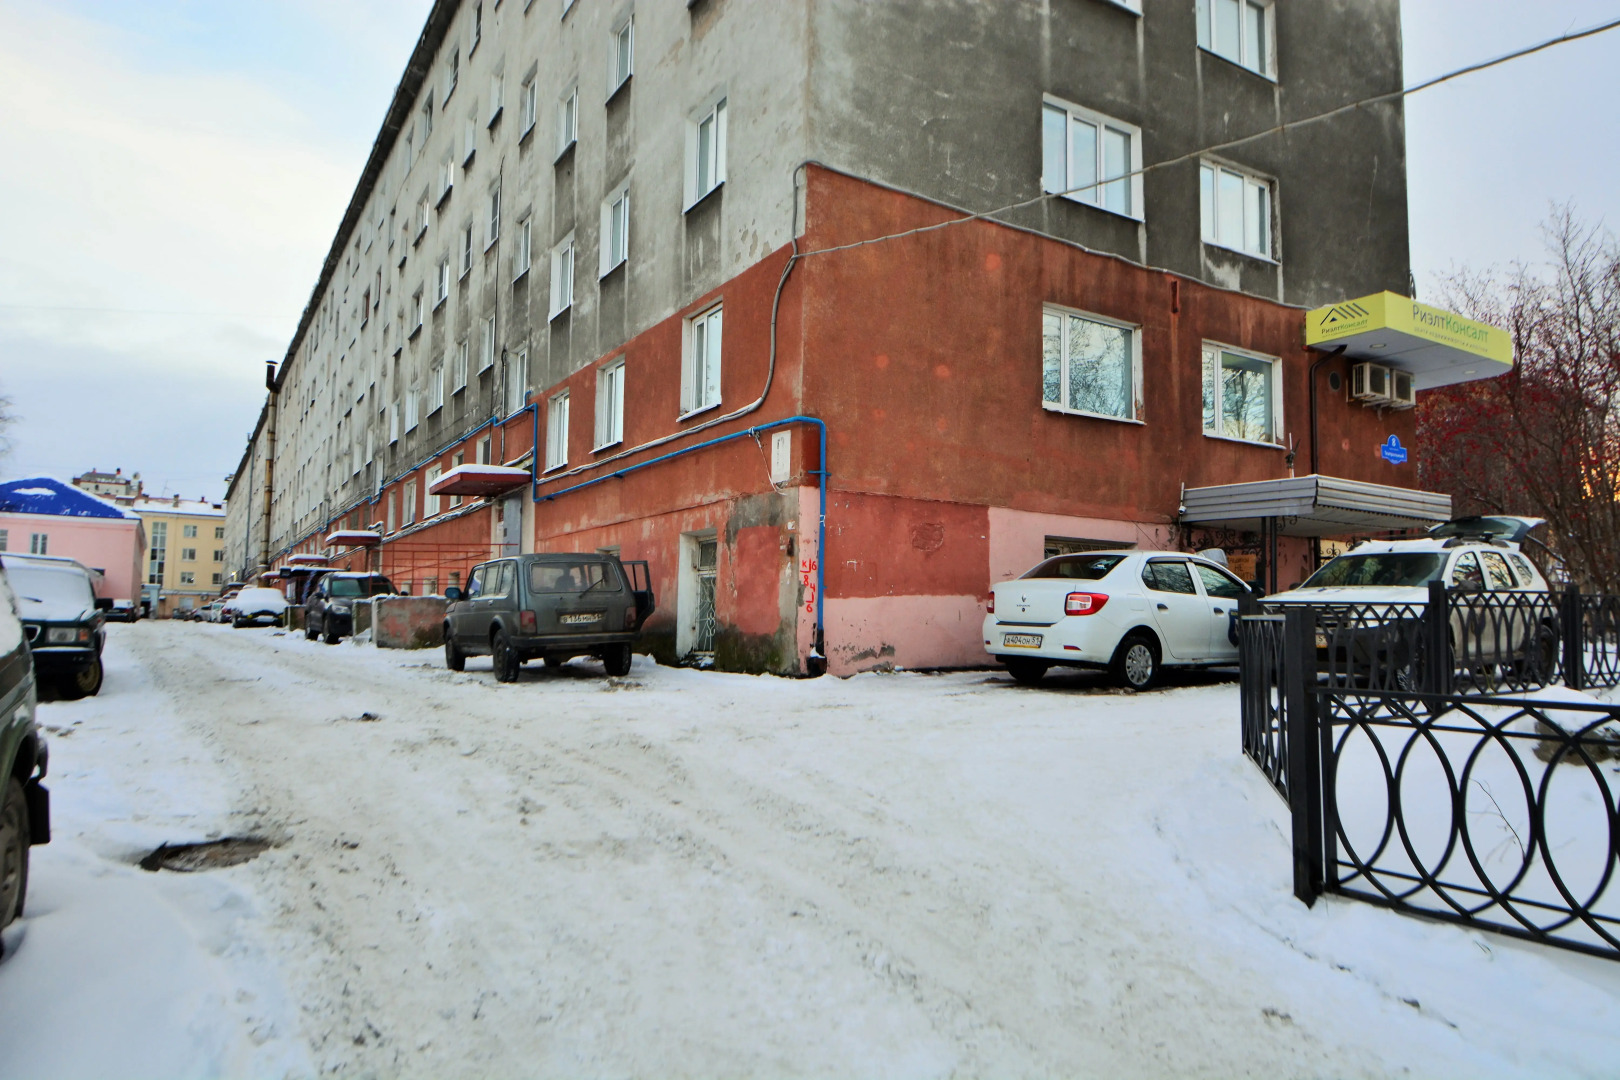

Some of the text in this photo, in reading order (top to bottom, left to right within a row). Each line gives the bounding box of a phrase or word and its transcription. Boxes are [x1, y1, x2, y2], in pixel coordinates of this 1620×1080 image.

[1321, 319, 1368, 334] РиэлтКонсалт
[1412, 304, 1489, 343] РиэлтКонсалт
[1392, 438, 1396, 447] 8
